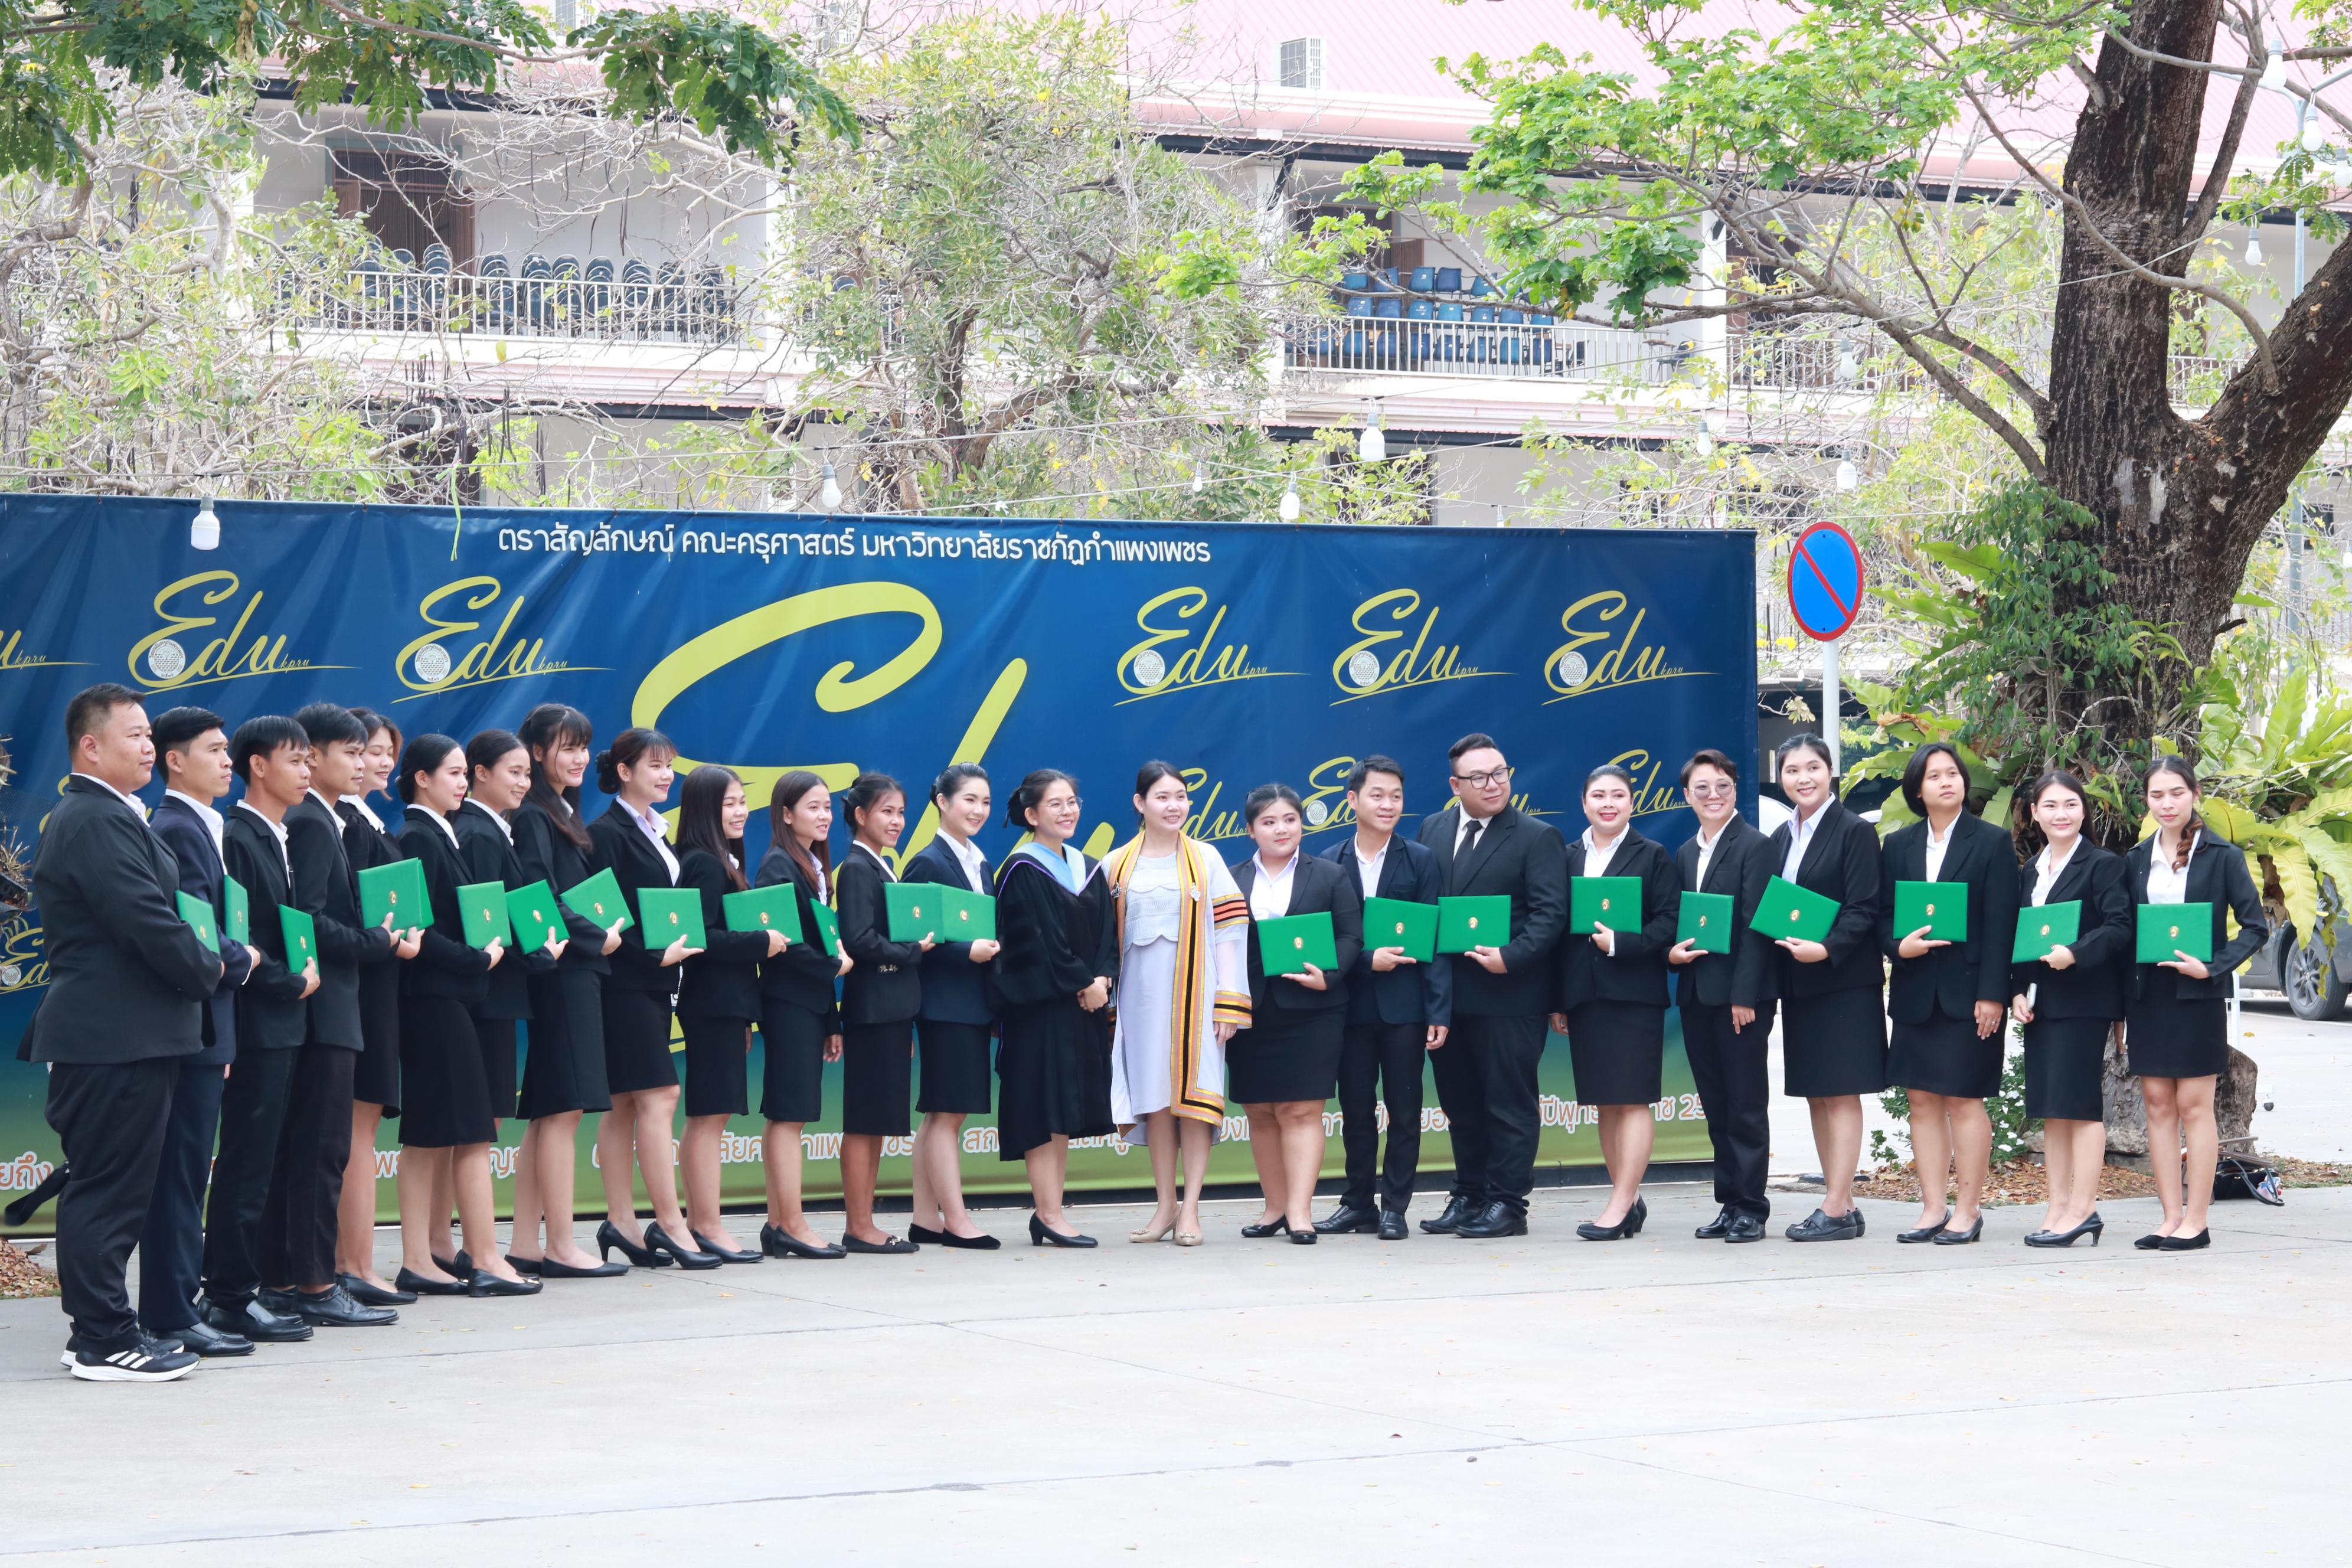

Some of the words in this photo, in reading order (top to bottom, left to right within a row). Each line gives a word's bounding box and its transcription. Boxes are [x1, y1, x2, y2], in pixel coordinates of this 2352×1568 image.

[499, 522, 675, 556] ตราสัญลักษณ์
[682, 527, 855, 564] คณะครุศาสตร์
[863, 530, 1211, 566] มหาวิทยาลัยราชภัฏกำแพงเพชร
[128, 570, 286, 688] Edu
[279, 654, 310, 674] kpru
[396, 576, 543, 691] Edu
[536, 656, 567, 676] kpru
[1117, 586, 1247, 695] Edu
[1332, 588, 1460, 695] Edu
[1544, 590, 1665, 694] Edu
